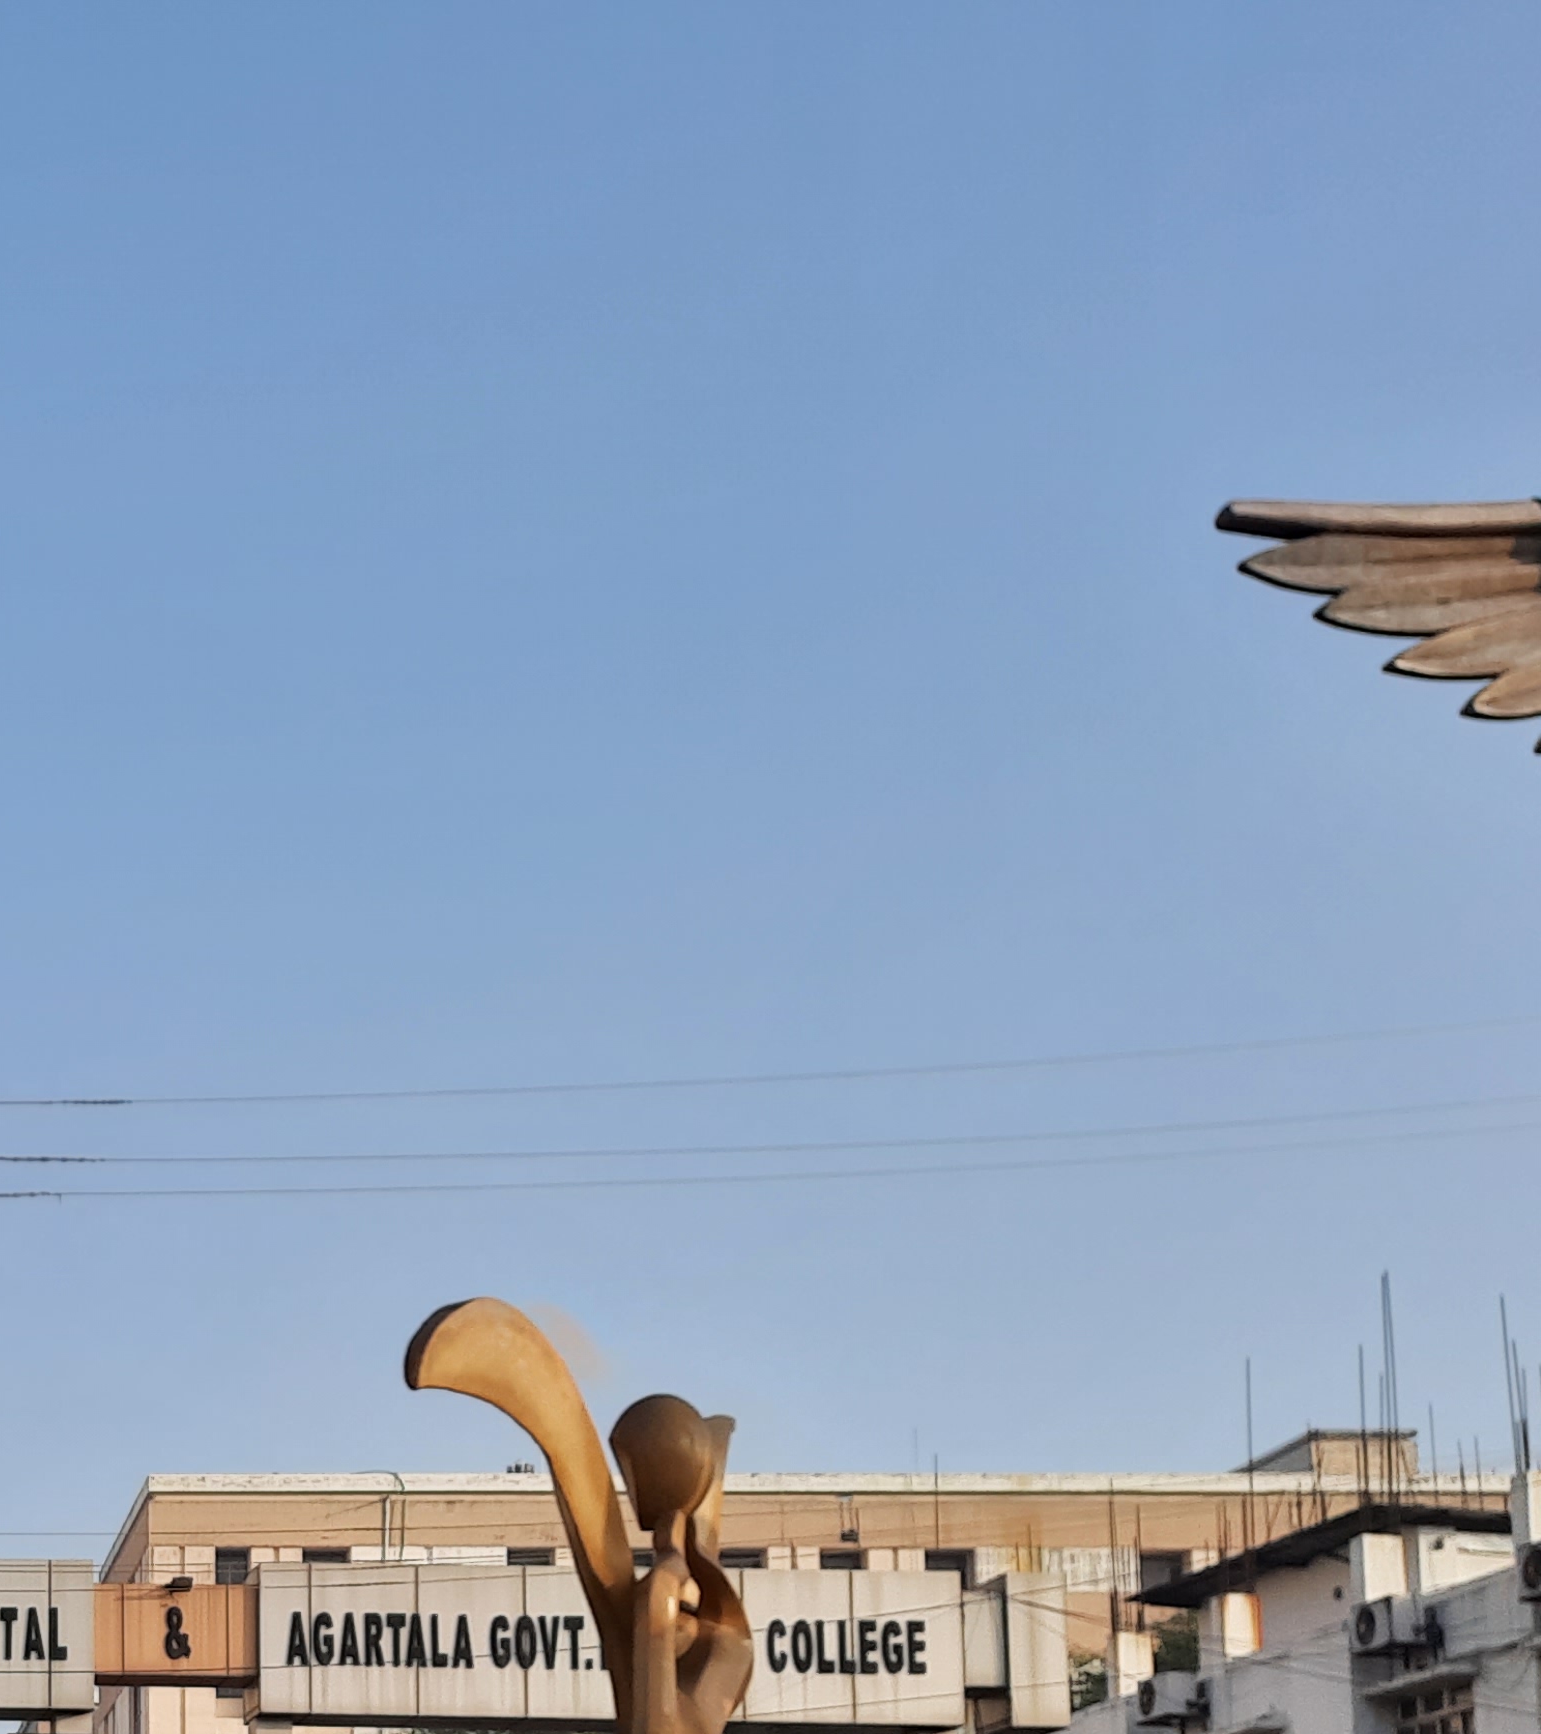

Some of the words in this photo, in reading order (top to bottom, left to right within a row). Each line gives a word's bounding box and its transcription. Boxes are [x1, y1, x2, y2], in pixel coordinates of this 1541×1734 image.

[164, 1606, 191, 1660] &
[286, 1611, 473, 1669] AGARTALA
[489, 1614, 594, 1670] GOVT.
[767, 1619, 926, 1676] COLLEGE
